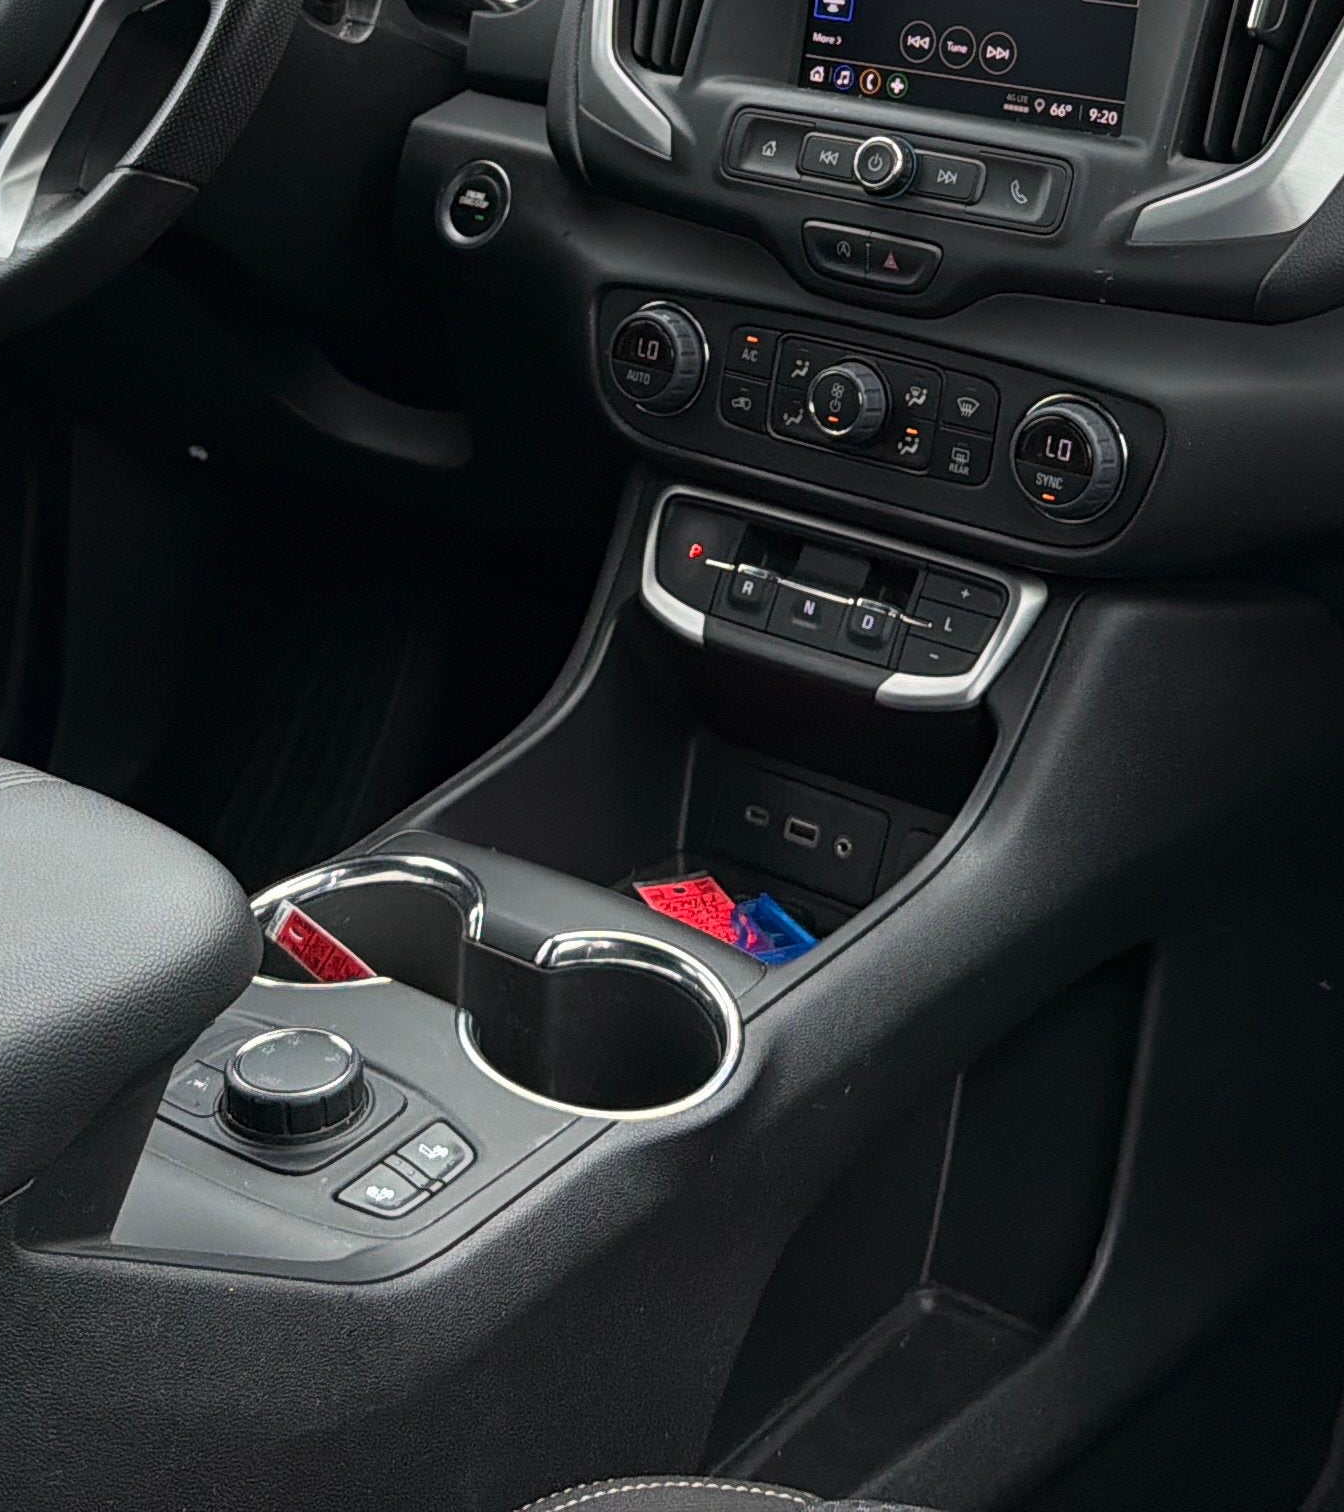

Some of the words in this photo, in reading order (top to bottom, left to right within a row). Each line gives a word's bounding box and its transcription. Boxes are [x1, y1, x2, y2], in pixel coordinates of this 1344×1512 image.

[812, 32, 835, 45] More
[946, 41, 968, 54] Tune
[1089, 108, 1118, 125] 9:20
[741, 348, 759, 363] A/C
[626, 369, 651, 385] AUTO
[948, 462, 970, 476] REAR
[1035, 472, 1064, 490] SYNC
[688, 542, 704, 560] P
[740, 580, 754, 596] R
[803, 599, 816, 616] N
[861, 614, 875, 630] D
[943, 617, 953, 633] L
